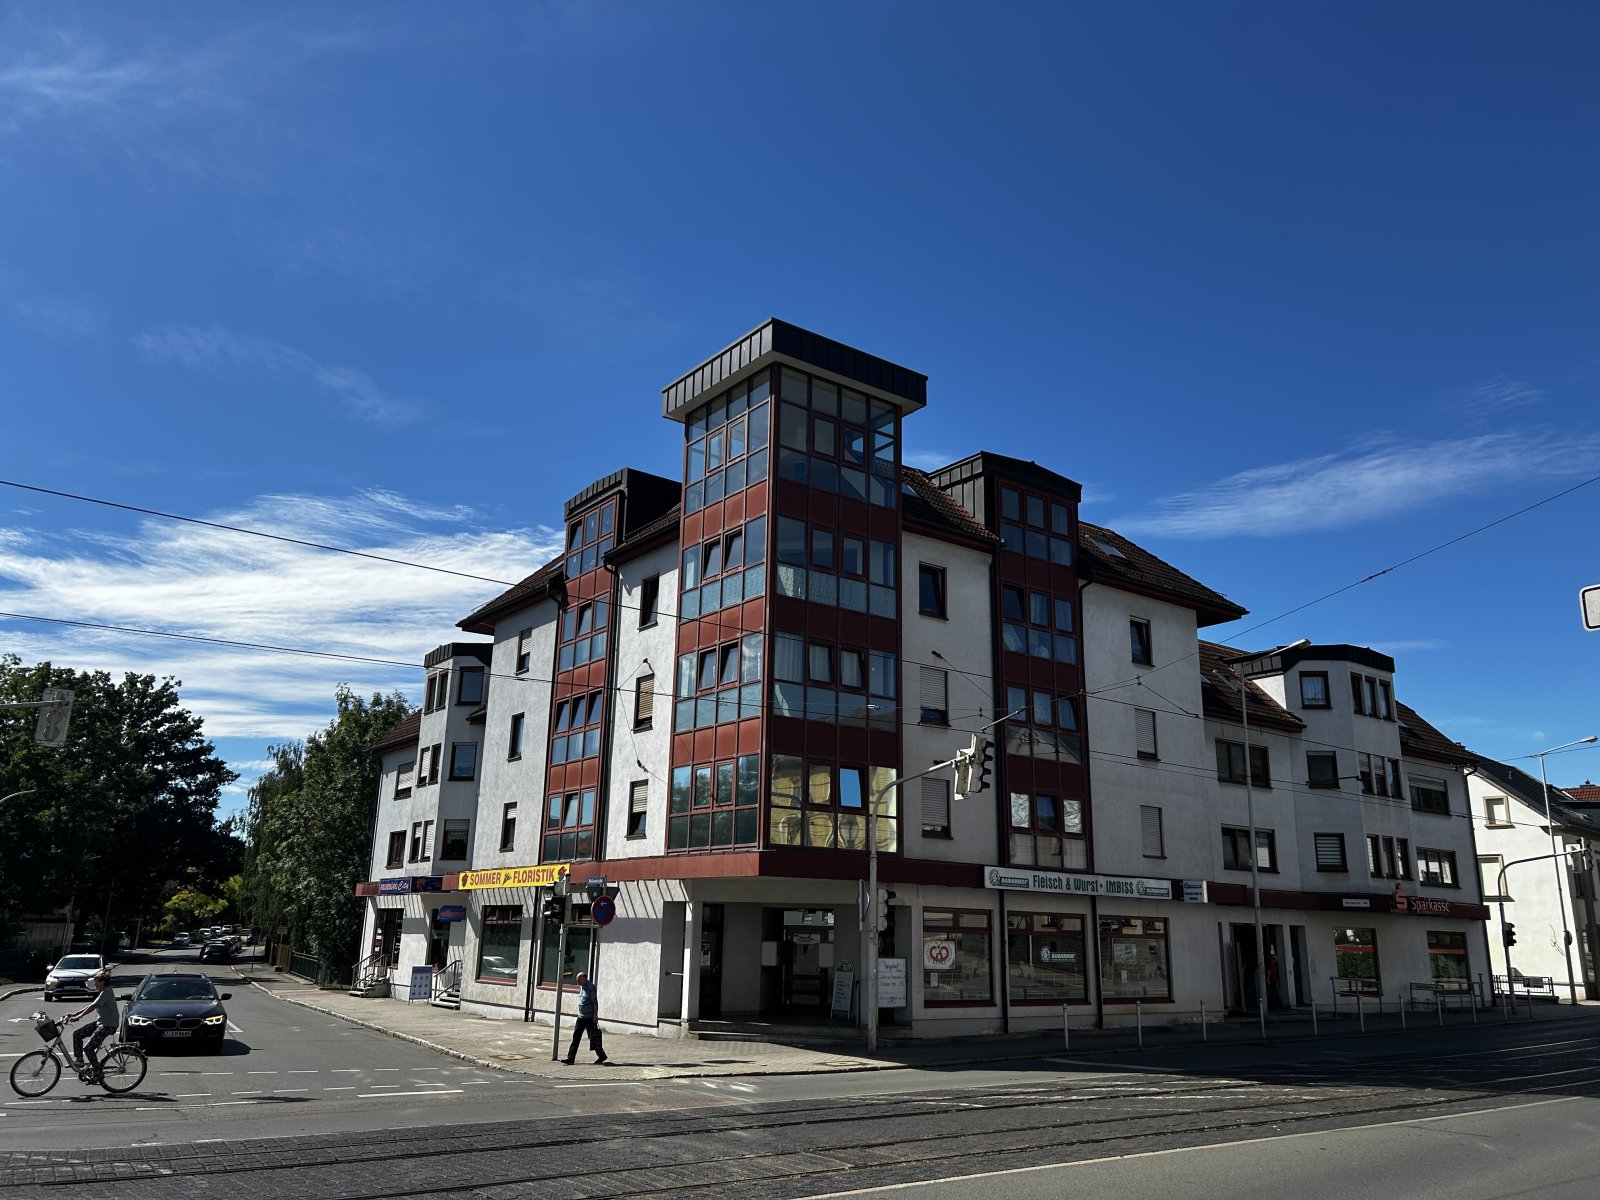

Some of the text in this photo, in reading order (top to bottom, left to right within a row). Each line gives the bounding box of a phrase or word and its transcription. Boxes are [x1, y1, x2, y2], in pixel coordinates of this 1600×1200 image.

[470, 868, 555, 886] SOMMER FLORISTIK
[1033, 874, 1134, 895] Fleisch & Wurst IMBISS
[1411, 897, 1450, 913] Sparkasse
